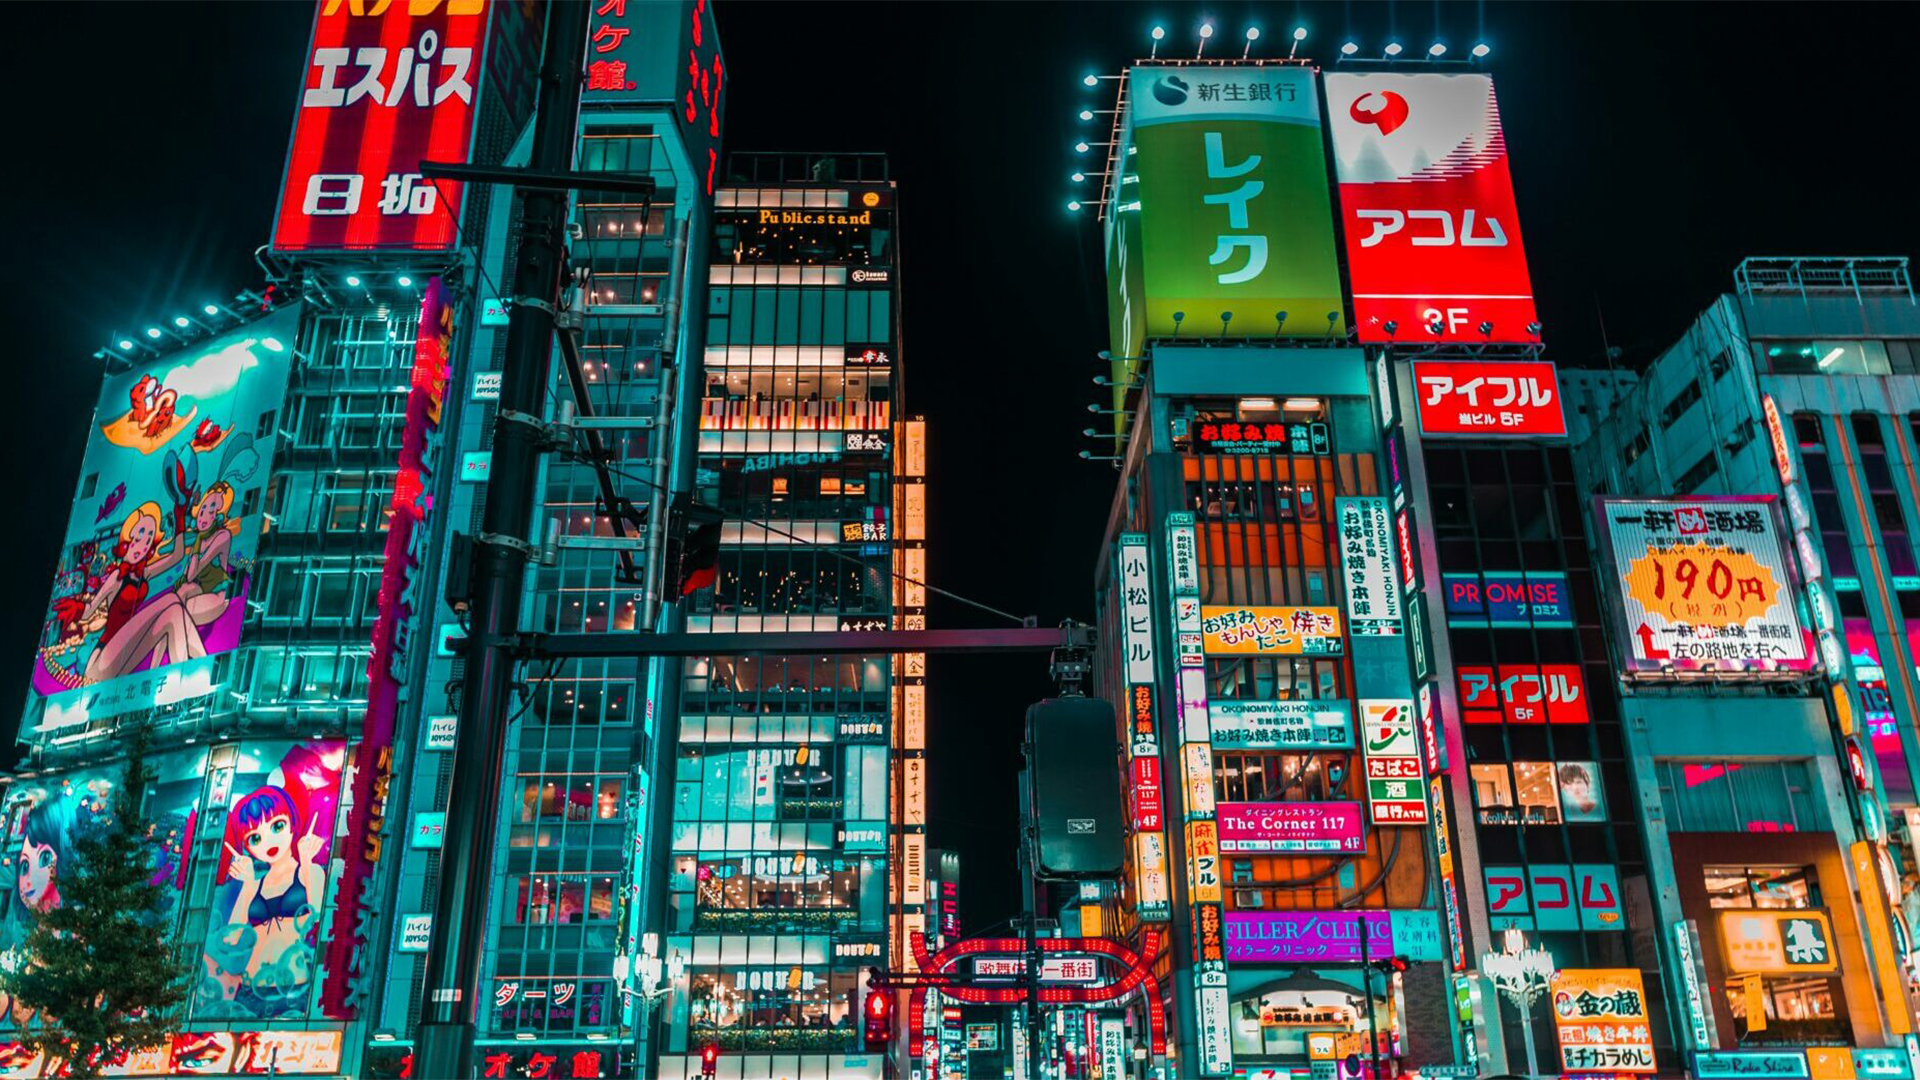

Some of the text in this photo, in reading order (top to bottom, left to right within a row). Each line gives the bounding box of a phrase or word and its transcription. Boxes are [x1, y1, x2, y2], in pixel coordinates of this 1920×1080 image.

[303, 30, 473, 107] エスパス
[1198, 83, 1296, 102] 新生銀行
[1204, 132, 1268, 284] レイク
[1356, 208, 1508, 247] アコム
[1423, 308, 1469, 335] 3F
[1421, 377, 1552, 407] アイフル
[1459, 412, 1524, 426] 当ビル 5F
[1344, 512, 1371, 615] お好み焼き本陣
[1374, 500, 1396, 615] OKONOMIYAKI HONJIN
[1652, 558, 1766, 602] 190円
[1452, 583, 1558, 603] PROMISE
[1126, 558, 1150, 661] 小松ビル
[1256, 629, 1291, 650] たこ
[1327, 639, 1341, 651] 7F
[1672, 642, 1787, 659] 左の路地を右へ
[1461, 674, 1579, 703] アイフル
[1221, 704, 1330, 713] OKONOMIYAKI HONJIN
[1514, 707, 1534, 719] 5F
[841, 723, 882, 735] DOUTOR
[1214, 729, 1311, 742] お好み焼き本陣
[1330, 728, 1345, 740] 2F
[1370, 759, 1418, 776] たばこ
[1141, 791, 1154, 799] 117
[1385, 781, 1407, 798] 酒
[419, 824, 441, 835] カラ
[1143, 815, 1157, 826] 4F
[1224, 817, 1345, 829] The Corner 117
[1344, 837, 1360, 849] 4F
[1488, 875, 1616, 910] アコム
[1225, 921, 1299, 940] FILLER
[836, 943, 881, 956] DOUTOR
[1270, 944, 1328, 955] クリニック
[1206, 974, 1221, 984] 8F
[496, 983, 575, 1007] ダーツ
[1576, 990, 1642, 1016] 金の蔵
[1575, 1047, 1652, 1068] チカラめし
